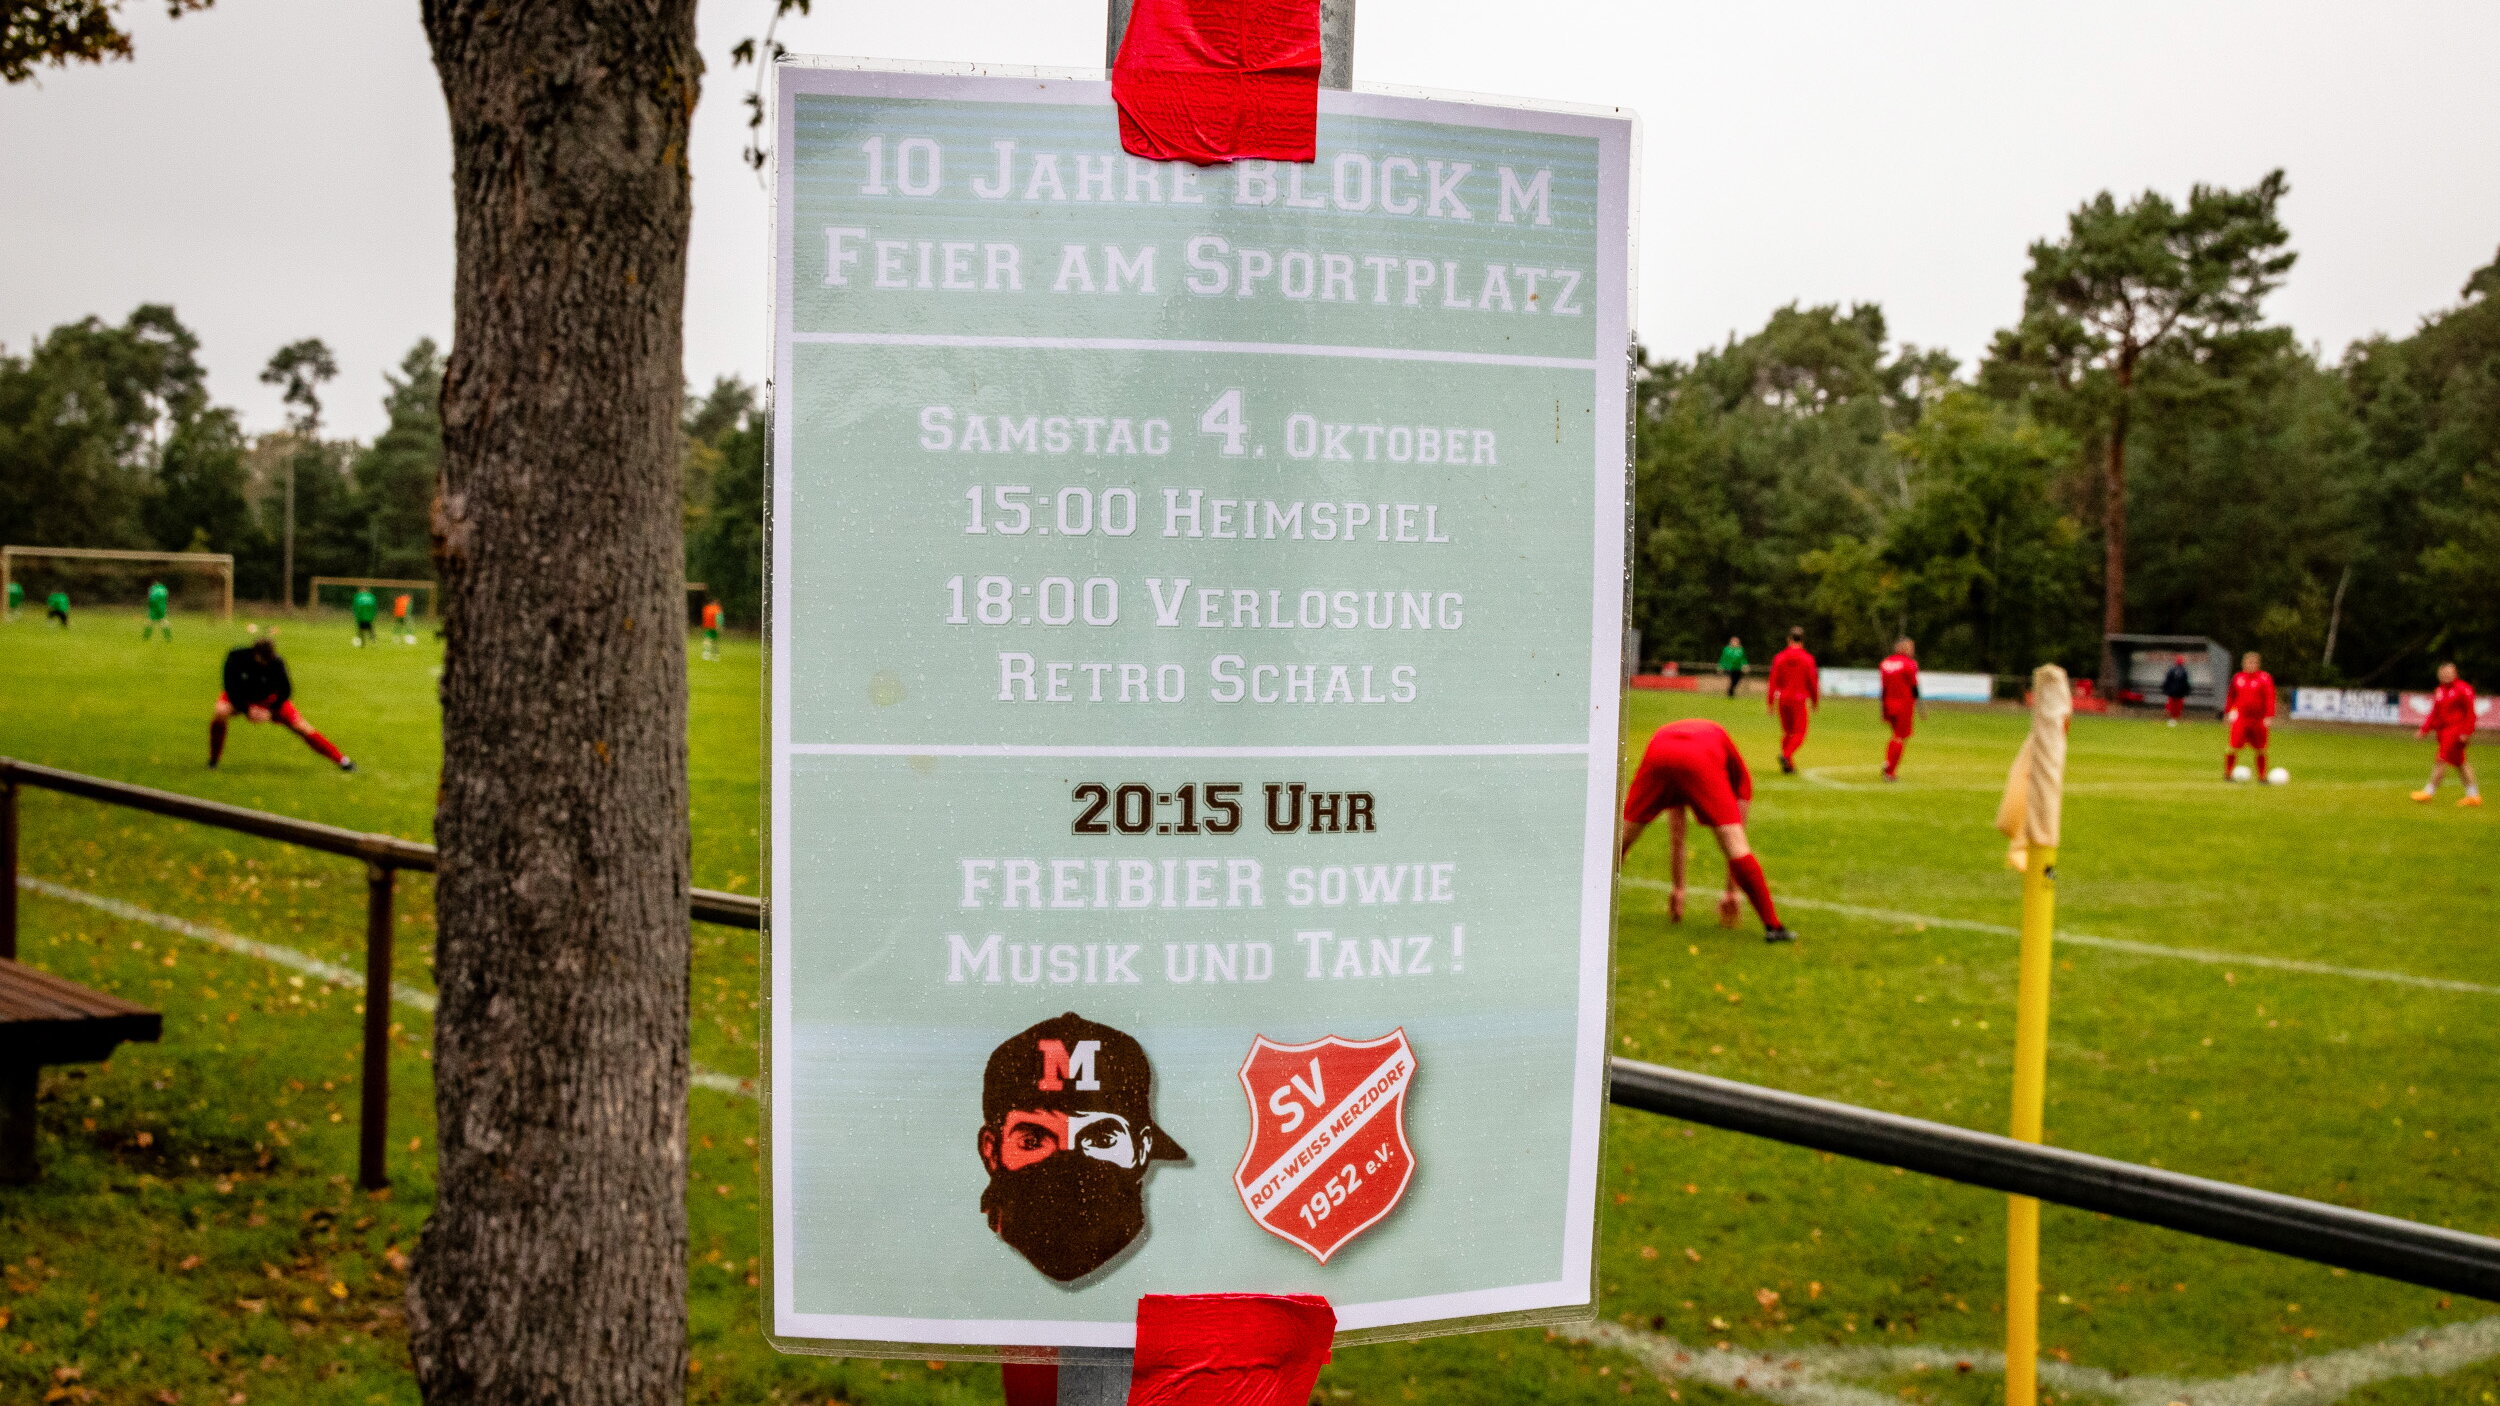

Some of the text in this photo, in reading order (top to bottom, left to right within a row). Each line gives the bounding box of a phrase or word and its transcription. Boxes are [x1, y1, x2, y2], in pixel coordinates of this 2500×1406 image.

[859, 134, 943, 197] 10
[1234, 152, 1474, 222] BLOCK
[1497, 164, 1553, 226] M
[822, 226, 1583, 316] FEIER AM SPORTPLATZ
[919, 388, 1499, 466] SAMSTAG 4. OKTOBER
[964, 484, 1452, 544] 15:00 HEIMSPIEL
[945, 574, 1465, 631] 18:00 VERLOSUNG
[997, 651, 1419, 706] RETRO SCHALS
[1071, 781, 1377, 836] 20:15 UHR
[959, 856, 1457, 910] FREIBIER SOWIE
[945, 932, 1143, 985] MUSIK
[1164, 941, 1274, 984] UND
[1037, 1039, 1101, 1092] M
[1268, 1056, 1326, 1134] SV
[1250, 1060, 1407, 1210] ROT-WEISS MERZDORF
[1299, 1142, 1395, 1230] 1952 e.V.
